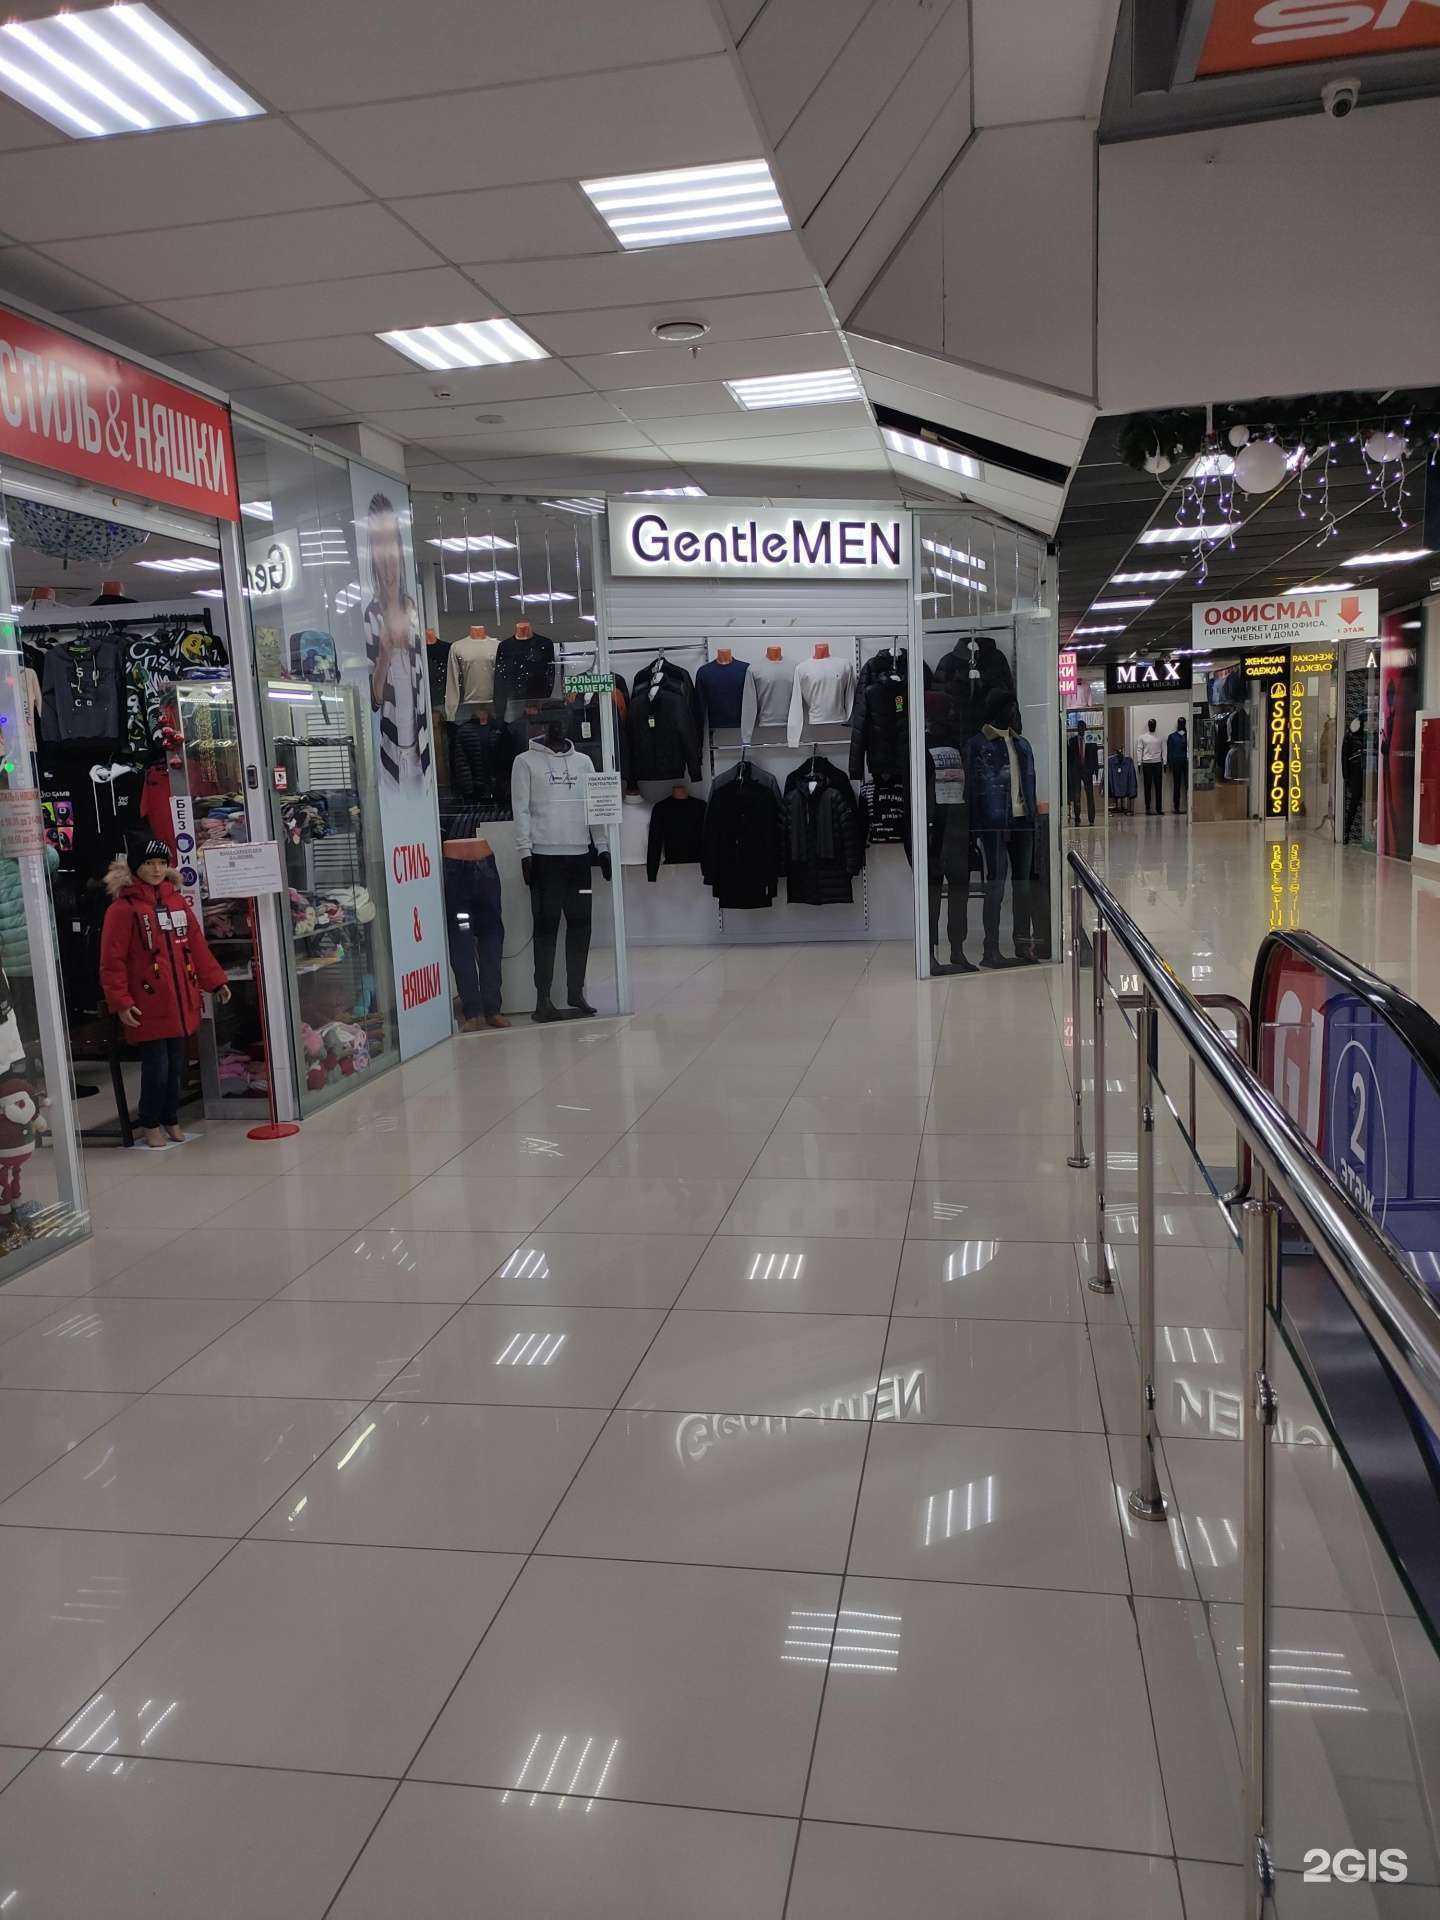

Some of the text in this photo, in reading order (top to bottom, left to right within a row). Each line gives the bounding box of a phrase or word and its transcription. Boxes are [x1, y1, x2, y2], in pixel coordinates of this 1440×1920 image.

[0, 339, 229, 496] СТИЛЬ & НЯШКИ
[631, 514, 900, 565] GentleMEN
[1204, 599, 1328, 626] ОФИСМАГ
[1204, 624, 1269, 636] ГИПЕРМАРКЕТ
[1270, 623, 1289, 632] ДЛЯ
[1231, 633, 1263, 641] УЧЕБЫ
[1274, 631, 1300, 640] ДОМА
[1117, 663, 1180, 683] MAX
[1245, 656, 1285, 666] ЖЕНСКАЯ
[1246, 666, 1283, 675] ОДЕЖДА
[564, 675, 614, 684] БОЛЬШИЕ
[565, 684, 614, 693] РАЗМЕРЫ
[1271, 700, 1286, 813] Santeros
[393, 843, 430, 884] СТИЛЬ
[413, 906, 422, 943] &
[401, 962, 441, 1011] НЯШКИ
[1350, 1071, 1366, 1165] 2
